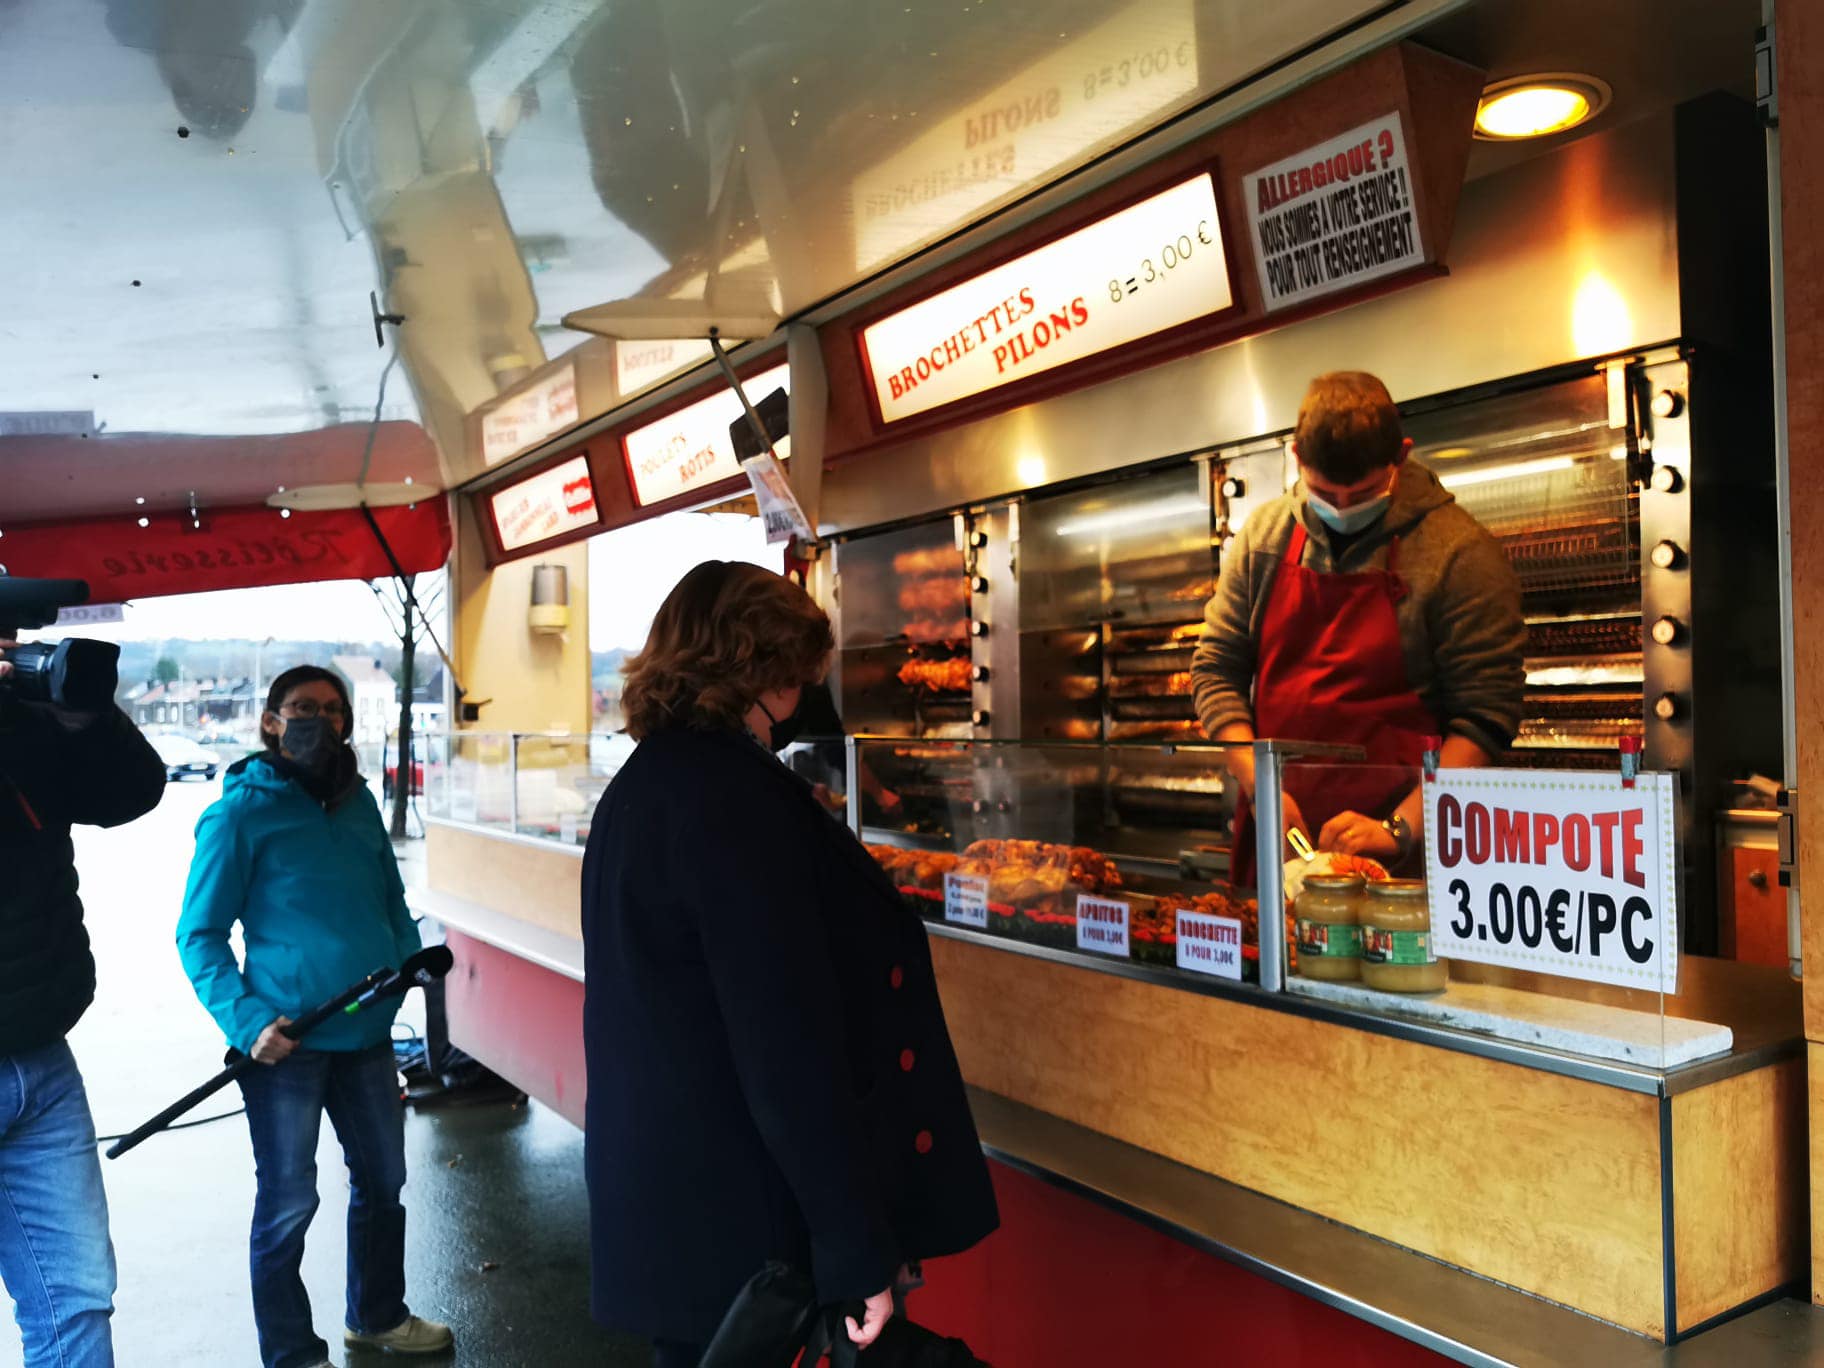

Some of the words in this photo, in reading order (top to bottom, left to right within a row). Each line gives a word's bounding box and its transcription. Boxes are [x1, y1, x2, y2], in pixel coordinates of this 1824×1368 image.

[1257, 139, 1377, 214] ALLERGIQUE
[1258, 214, 1286, 258] NOUS
[1283, 201, 1322, 248] SOMMES
[1319, 197, 1331, 234] A
[1327, 185, 1361, 233] VOTRE
[1358, 169, 1401, 222] SERVICE
[1265, 253, 1298, 299] POUR
[1294, 243, 1325, 289] TOUT
[1322, 211, 1415, 281] RENSEIGNEMENT
[887, 287, 1036, 401] BROCHETTES
[991, 297, 1090, 374] PILONS
[1437, 792, 1647, 889] COMPOTE
[1191, 944, 1211, 961] POUR
[1447, 878, 1655, 964] 3.00€/PC
